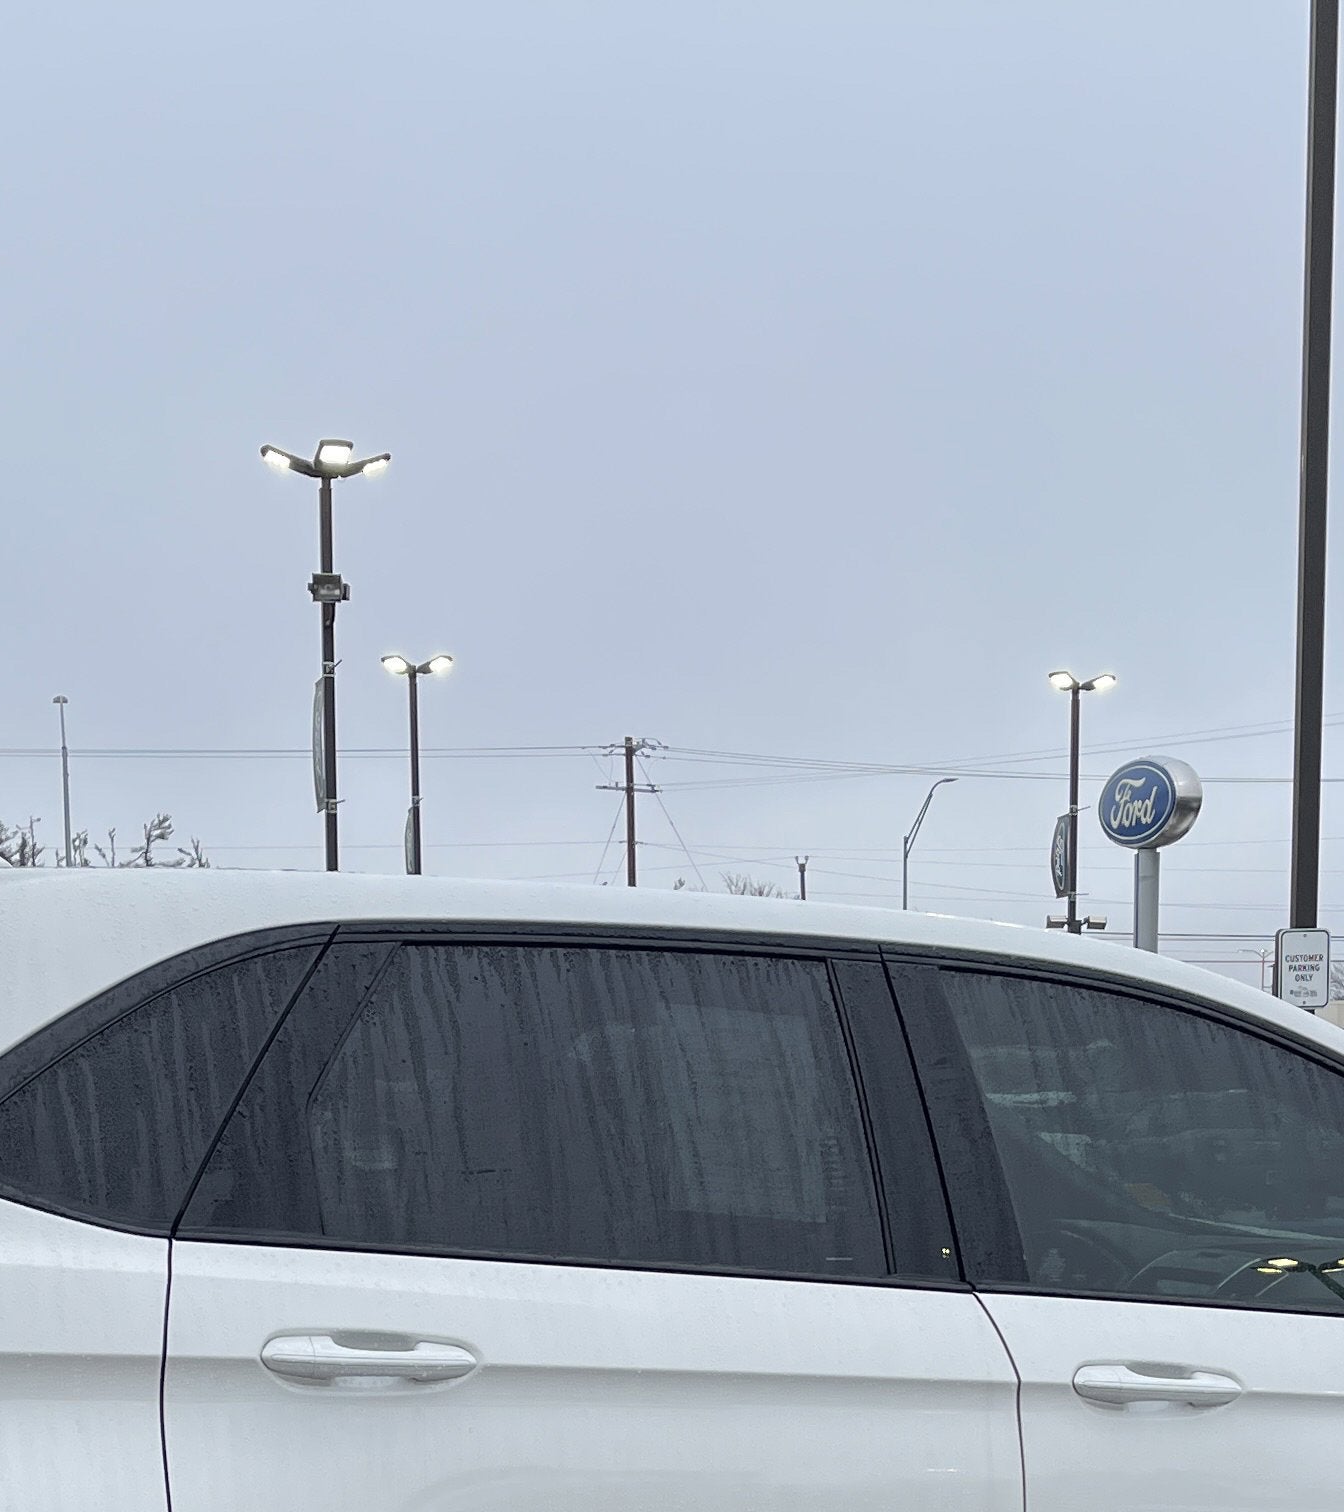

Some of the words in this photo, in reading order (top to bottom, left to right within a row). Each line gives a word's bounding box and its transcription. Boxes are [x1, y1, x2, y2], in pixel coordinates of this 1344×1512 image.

[1110, 777, 1158, 829] Ford
[1284, 953, 1324, 963] CUSTOMER
[1288, 964, 1321, 972] PARKING
[1294, 973, 1314, 982] ONLY
